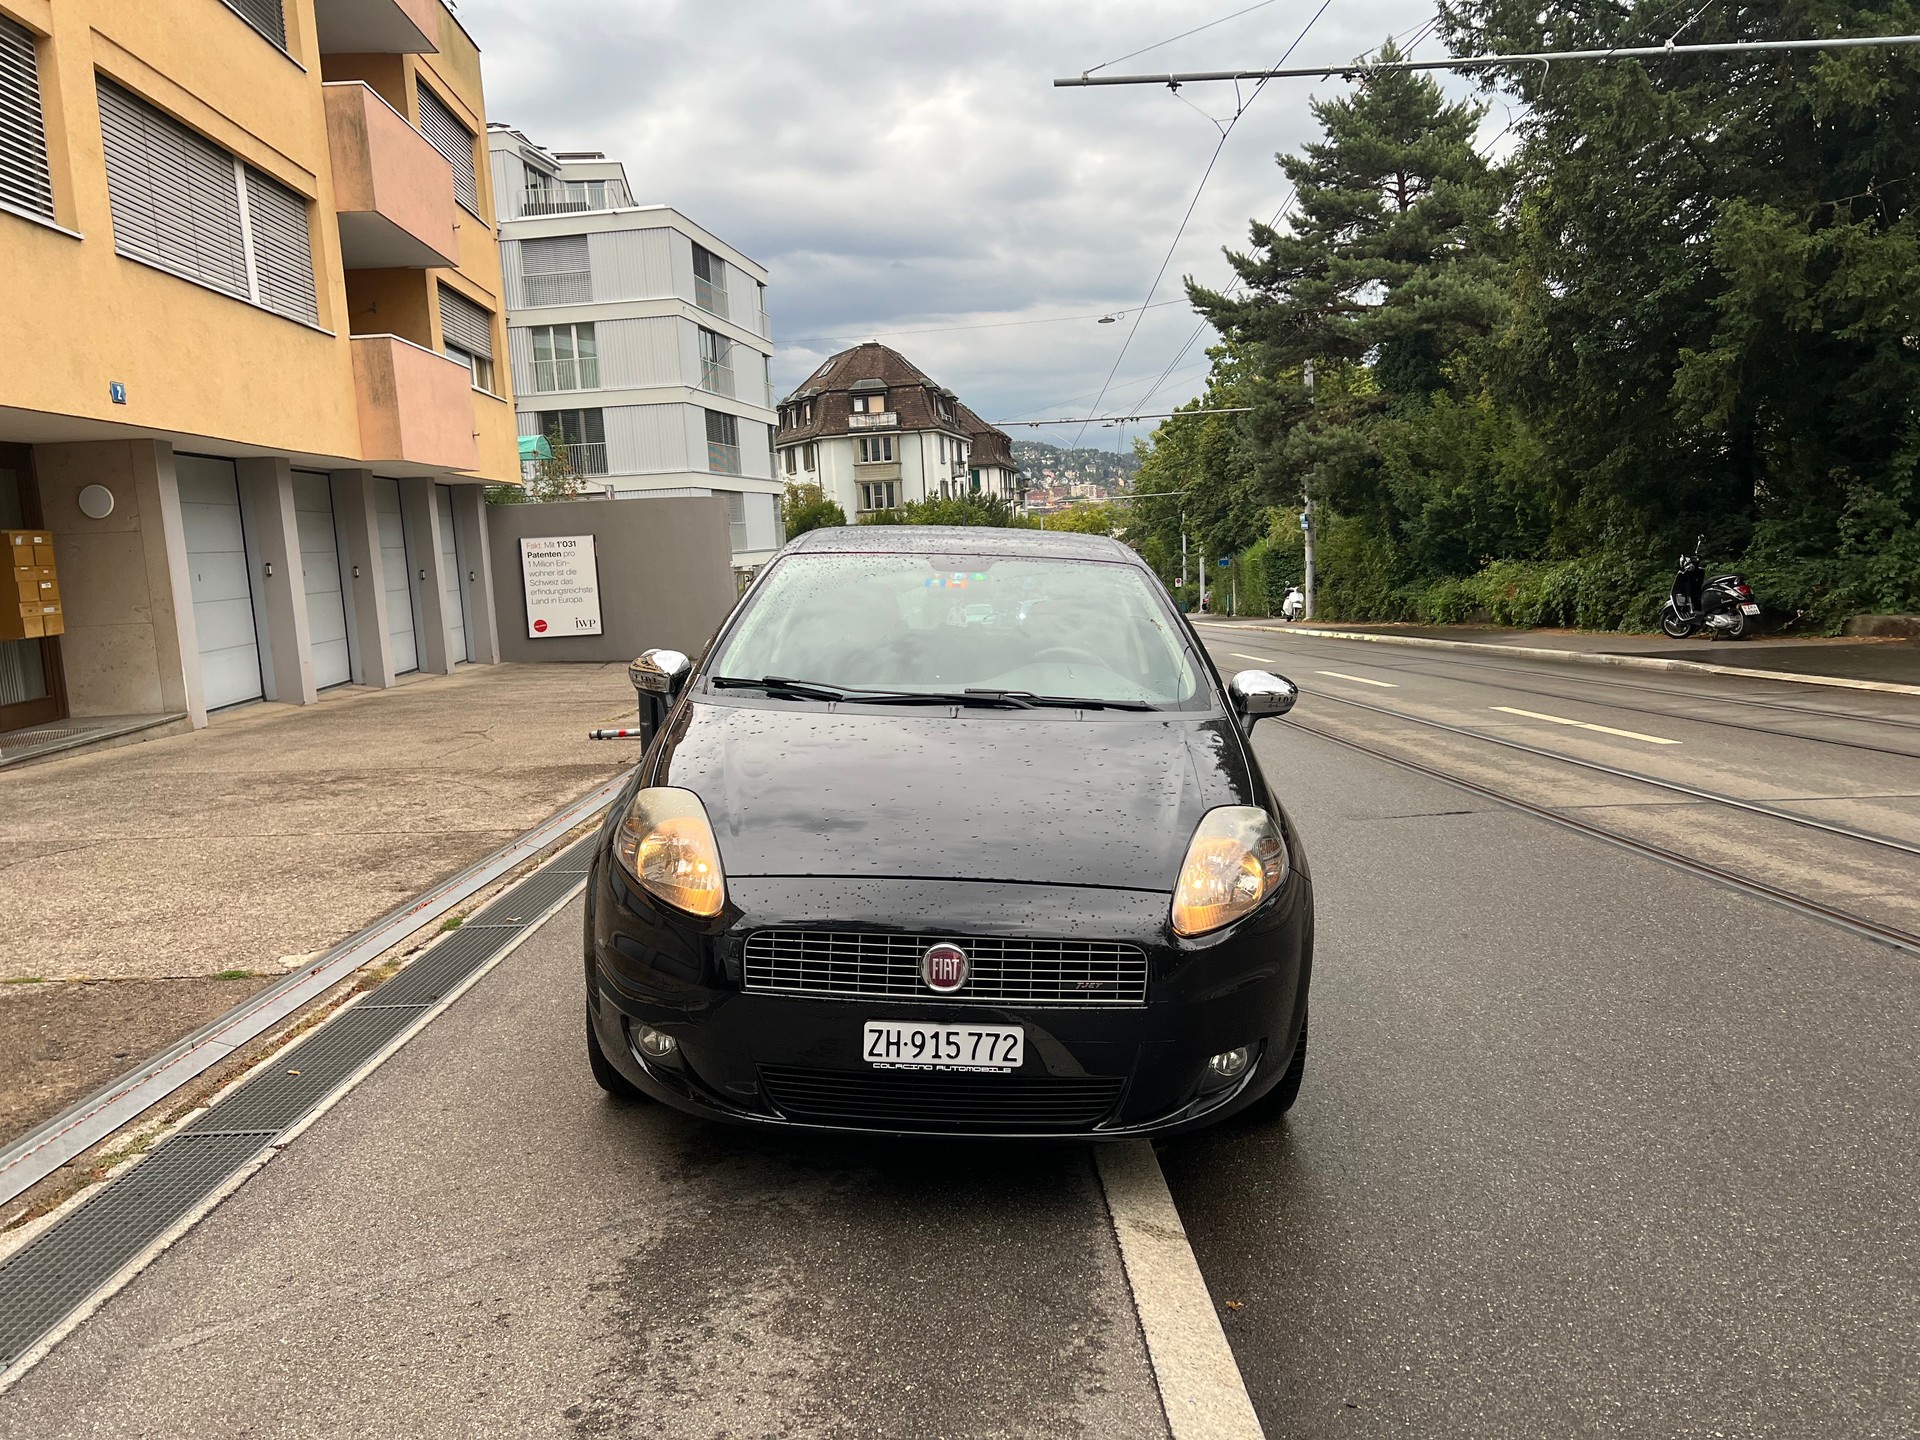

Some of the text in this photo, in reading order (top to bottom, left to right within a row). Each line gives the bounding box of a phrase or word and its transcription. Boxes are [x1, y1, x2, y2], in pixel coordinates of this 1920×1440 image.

[116, 385, 122, 400] 2
[544, 541, 556, 549] Mit
[557, 540, 577, 548] 1'031
[533, 560, 555, 568] Million
[556, 559, 570, 567] Ein-
[529, 579, 559, 587] Schweiz
[530, 587, 593, 596] erfindungsreichste
[531, 597, 550, 605] Land
[932, 958, 960, 980] FIAT
[872, 1062, 1012, 1073] COLACINO AUTOMOBILE
